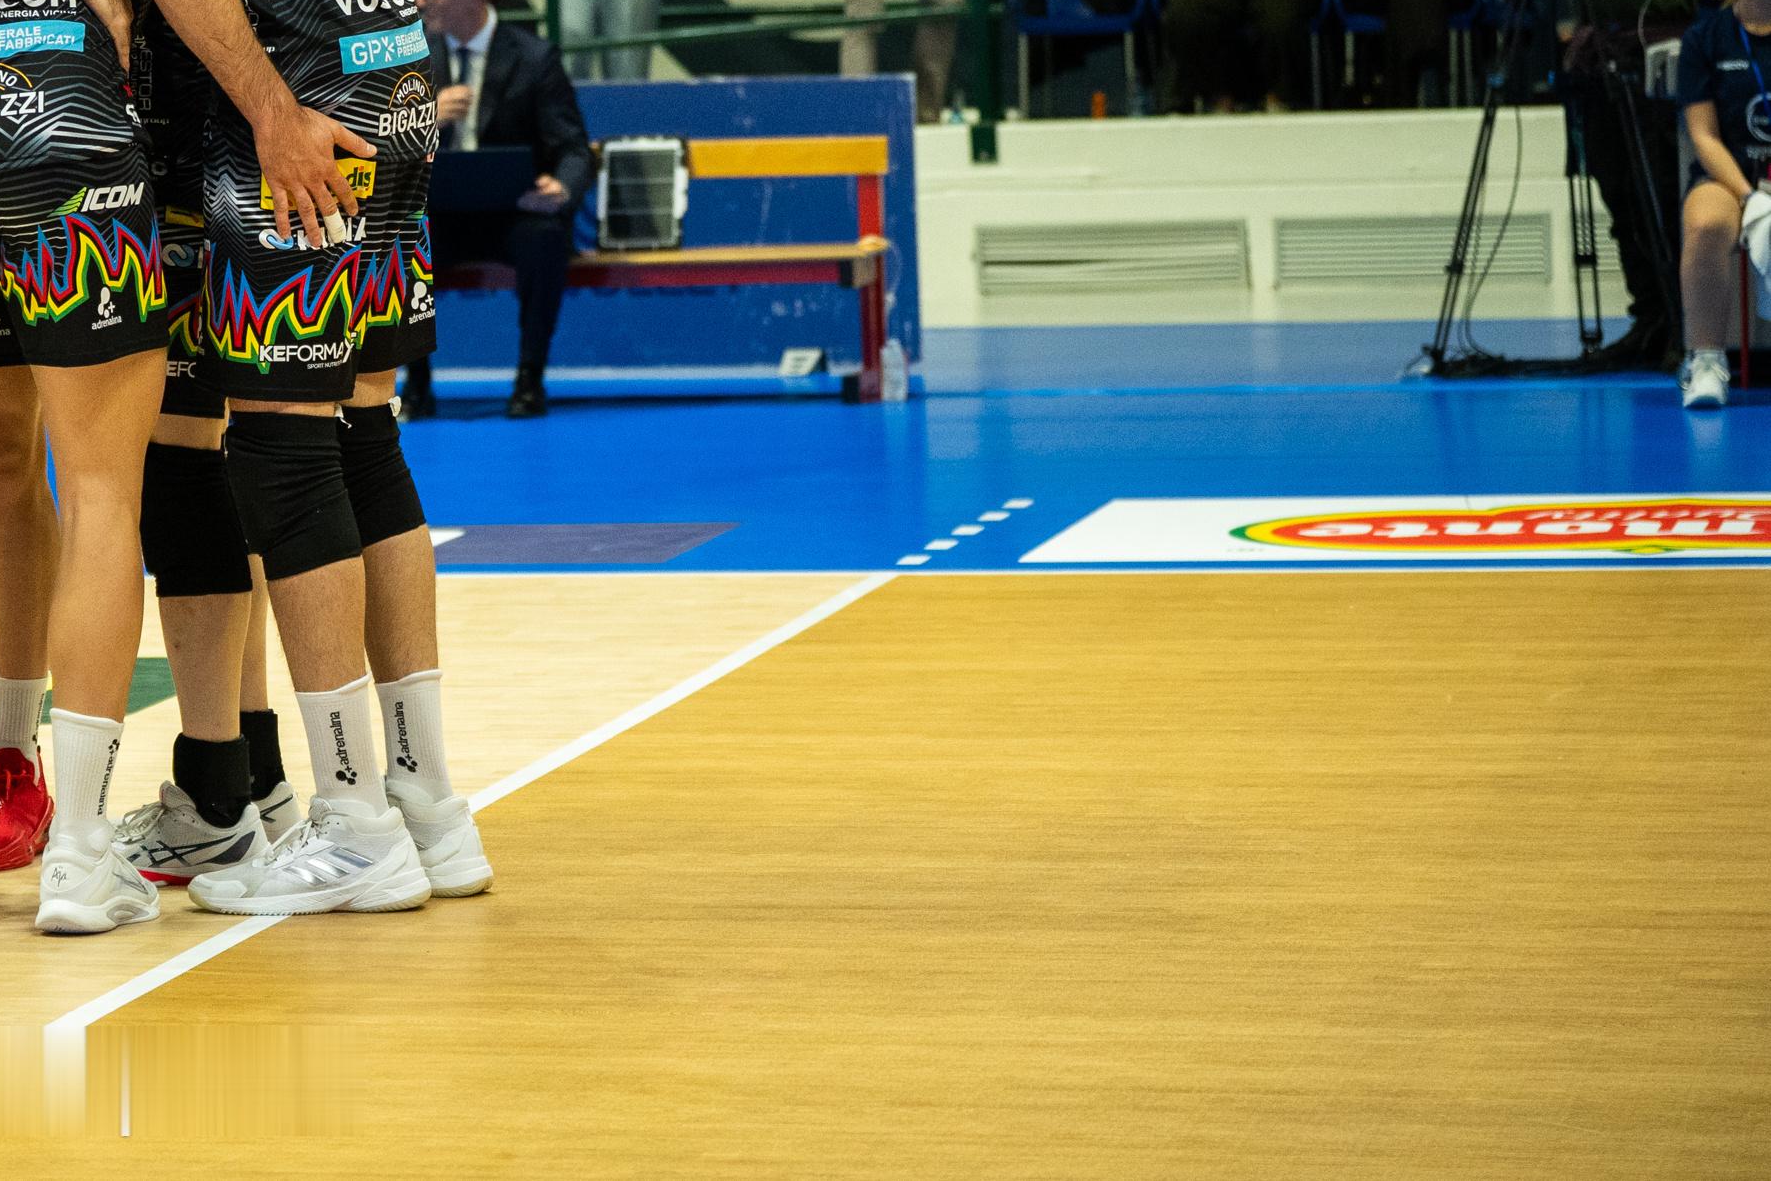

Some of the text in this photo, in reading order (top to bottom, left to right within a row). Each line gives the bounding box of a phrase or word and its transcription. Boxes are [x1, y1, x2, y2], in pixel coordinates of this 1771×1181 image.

[396, 78, 426, 103] MOLINO
[378, 100, 436, 137] BIGAZZI
[346, 165, 372, 188] dis
[81, 182, 145, 213] ICOM
[91, 314, 123, 330] adrenalina
[408, 307, 436, 326] adrenali
[259, 341, 344, 363] KEFORMA
[307, 359, 344, 370] SPORT NUTRI
[331, 710, 348, 766] adrenalina
[396, 701, 409, 754] adrenalina
